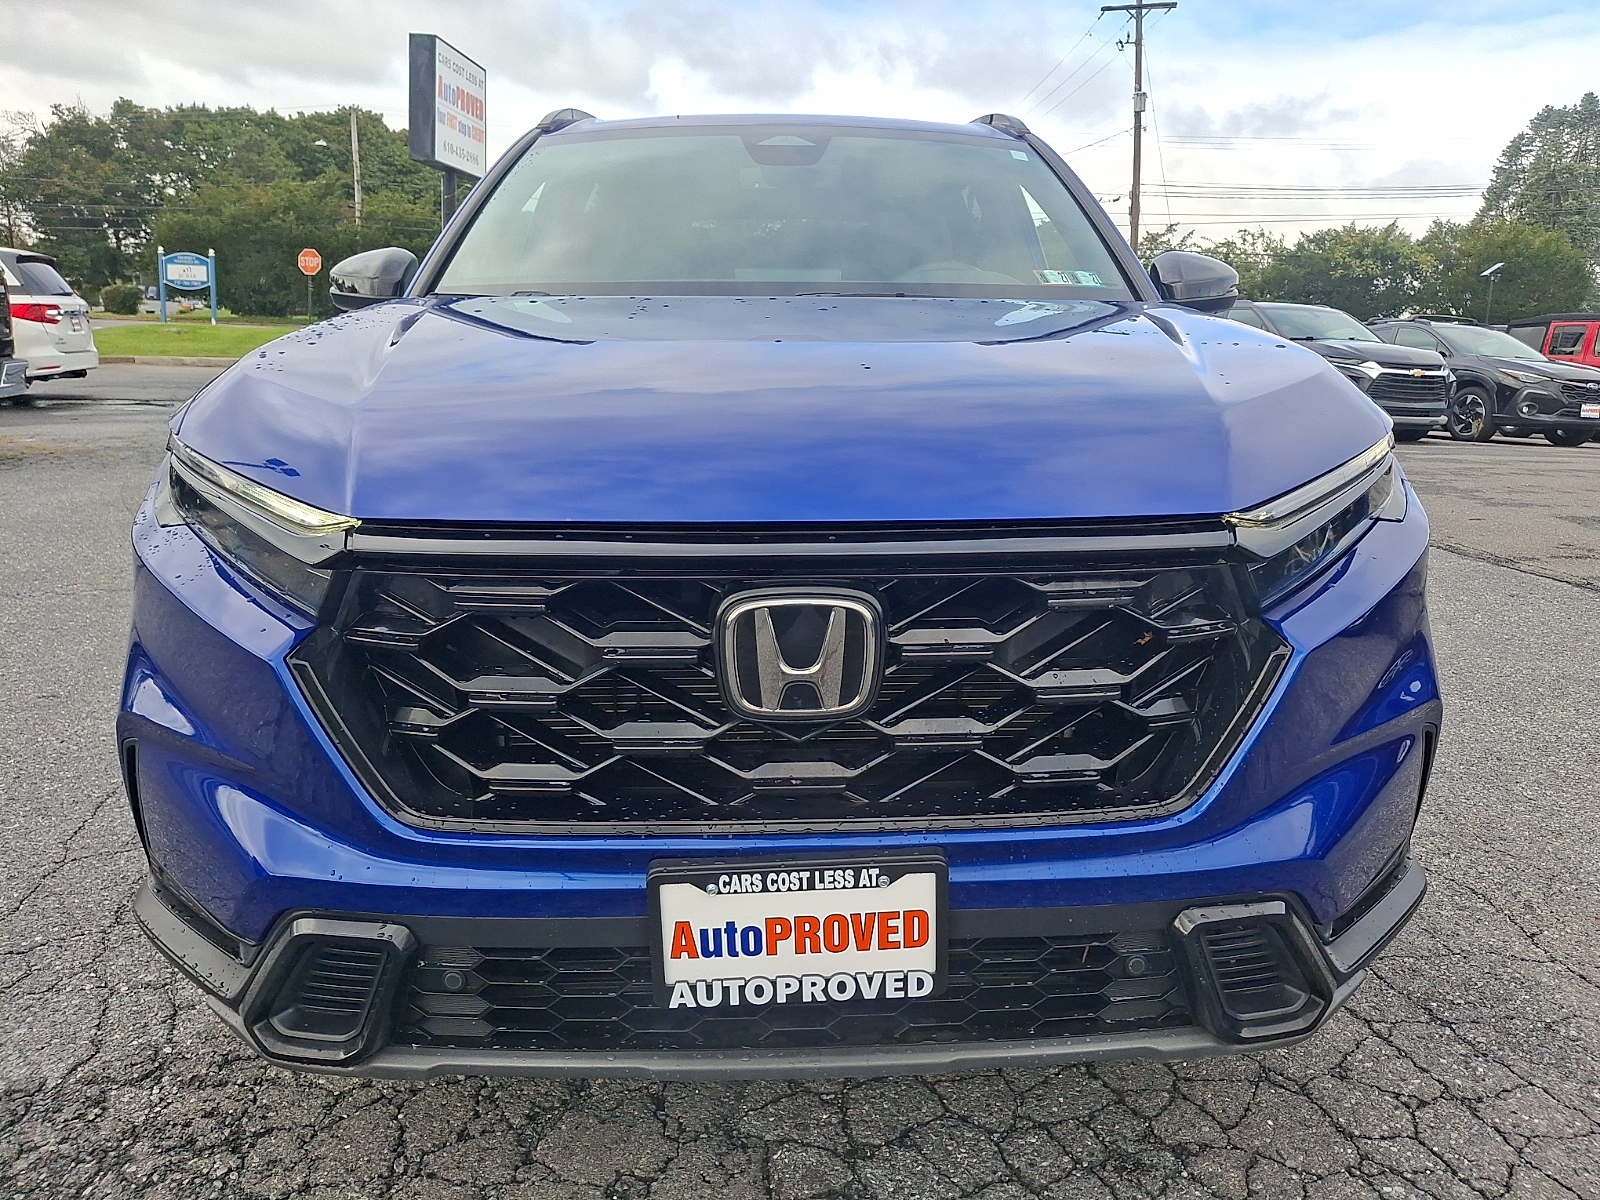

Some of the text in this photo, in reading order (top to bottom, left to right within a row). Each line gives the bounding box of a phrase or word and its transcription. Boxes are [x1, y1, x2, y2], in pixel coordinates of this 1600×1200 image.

[438, 52, 484, 90] CARS COST LESS AT
[438, 75, 484, 121] AutoPROVED
[300, 256, 319, 267] STOP
[718, 868, 880, 894] CARS COST LESS AT
[670, 909, 930, 959] AutoPROVED
[668, 971, 934, 1009] AUTOPROVED
